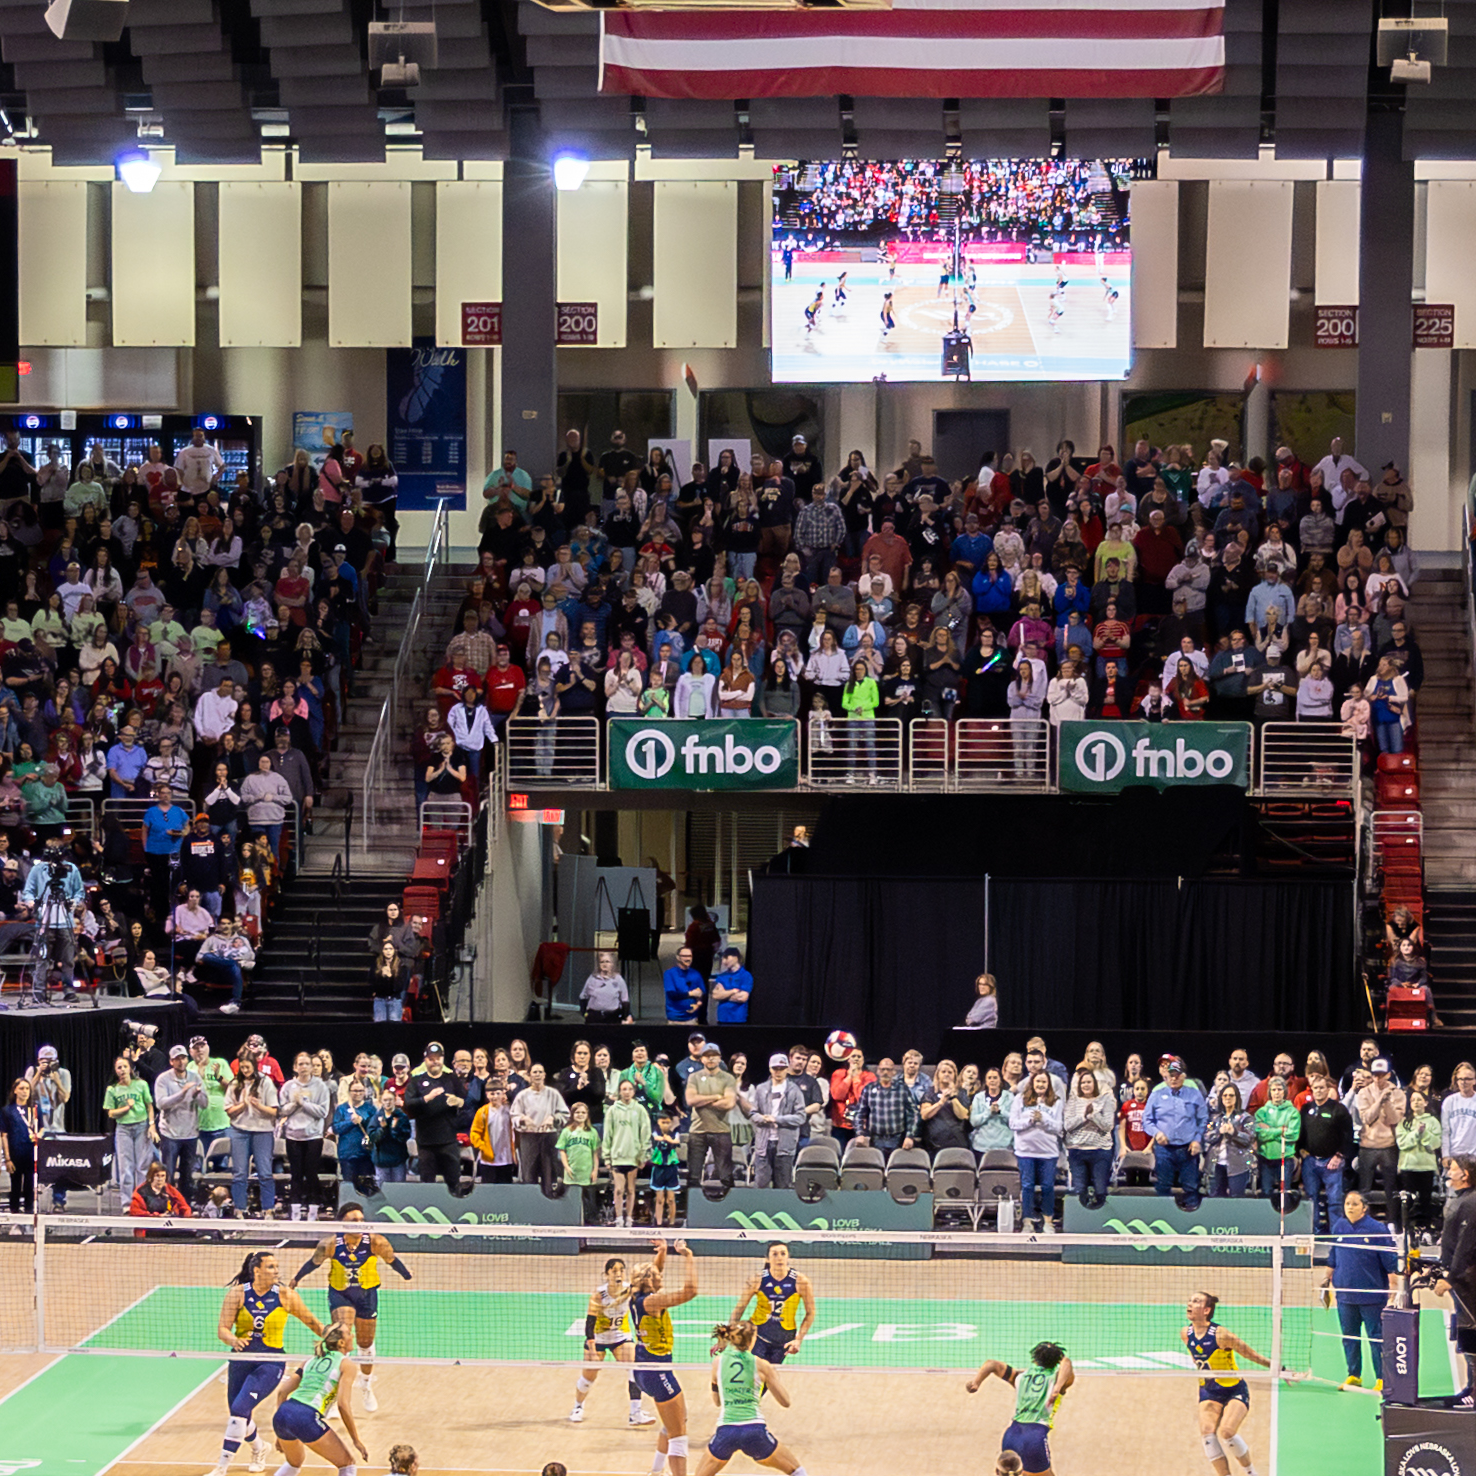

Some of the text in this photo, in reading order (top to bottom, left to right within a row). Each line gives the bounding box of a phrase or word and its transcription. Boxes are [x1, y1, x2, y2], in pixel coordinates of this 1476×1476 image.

[465, 306, 500, 314] SECTION
[560, 306, 595, 314] SECTION
[1318, 309, 1353, 317] SECTION
[1416, 308, 1452, 316] SECTION
[467, 315, 499, 332] 201
[559, 315, 596, 332] 200
[1316, 319, 1355, 336] 200
[1415, 318, 1453, 335] 225
[681, 733, 782, 774] fnbo
[1132, 737, 1233, 778] fnbo
[482, 1213, 509, 1222] LOVB
[832, 1218, 860, 1227] LOVB
[1211, 1226, 1239, 1235] LOVB
[253, 1315, 265, 1330] 6
[1395, 1336, 1408, 1375] LOVB
[729, 1361, 745, 1384] 2
[1023, 1373, 1046, 1394] 19
